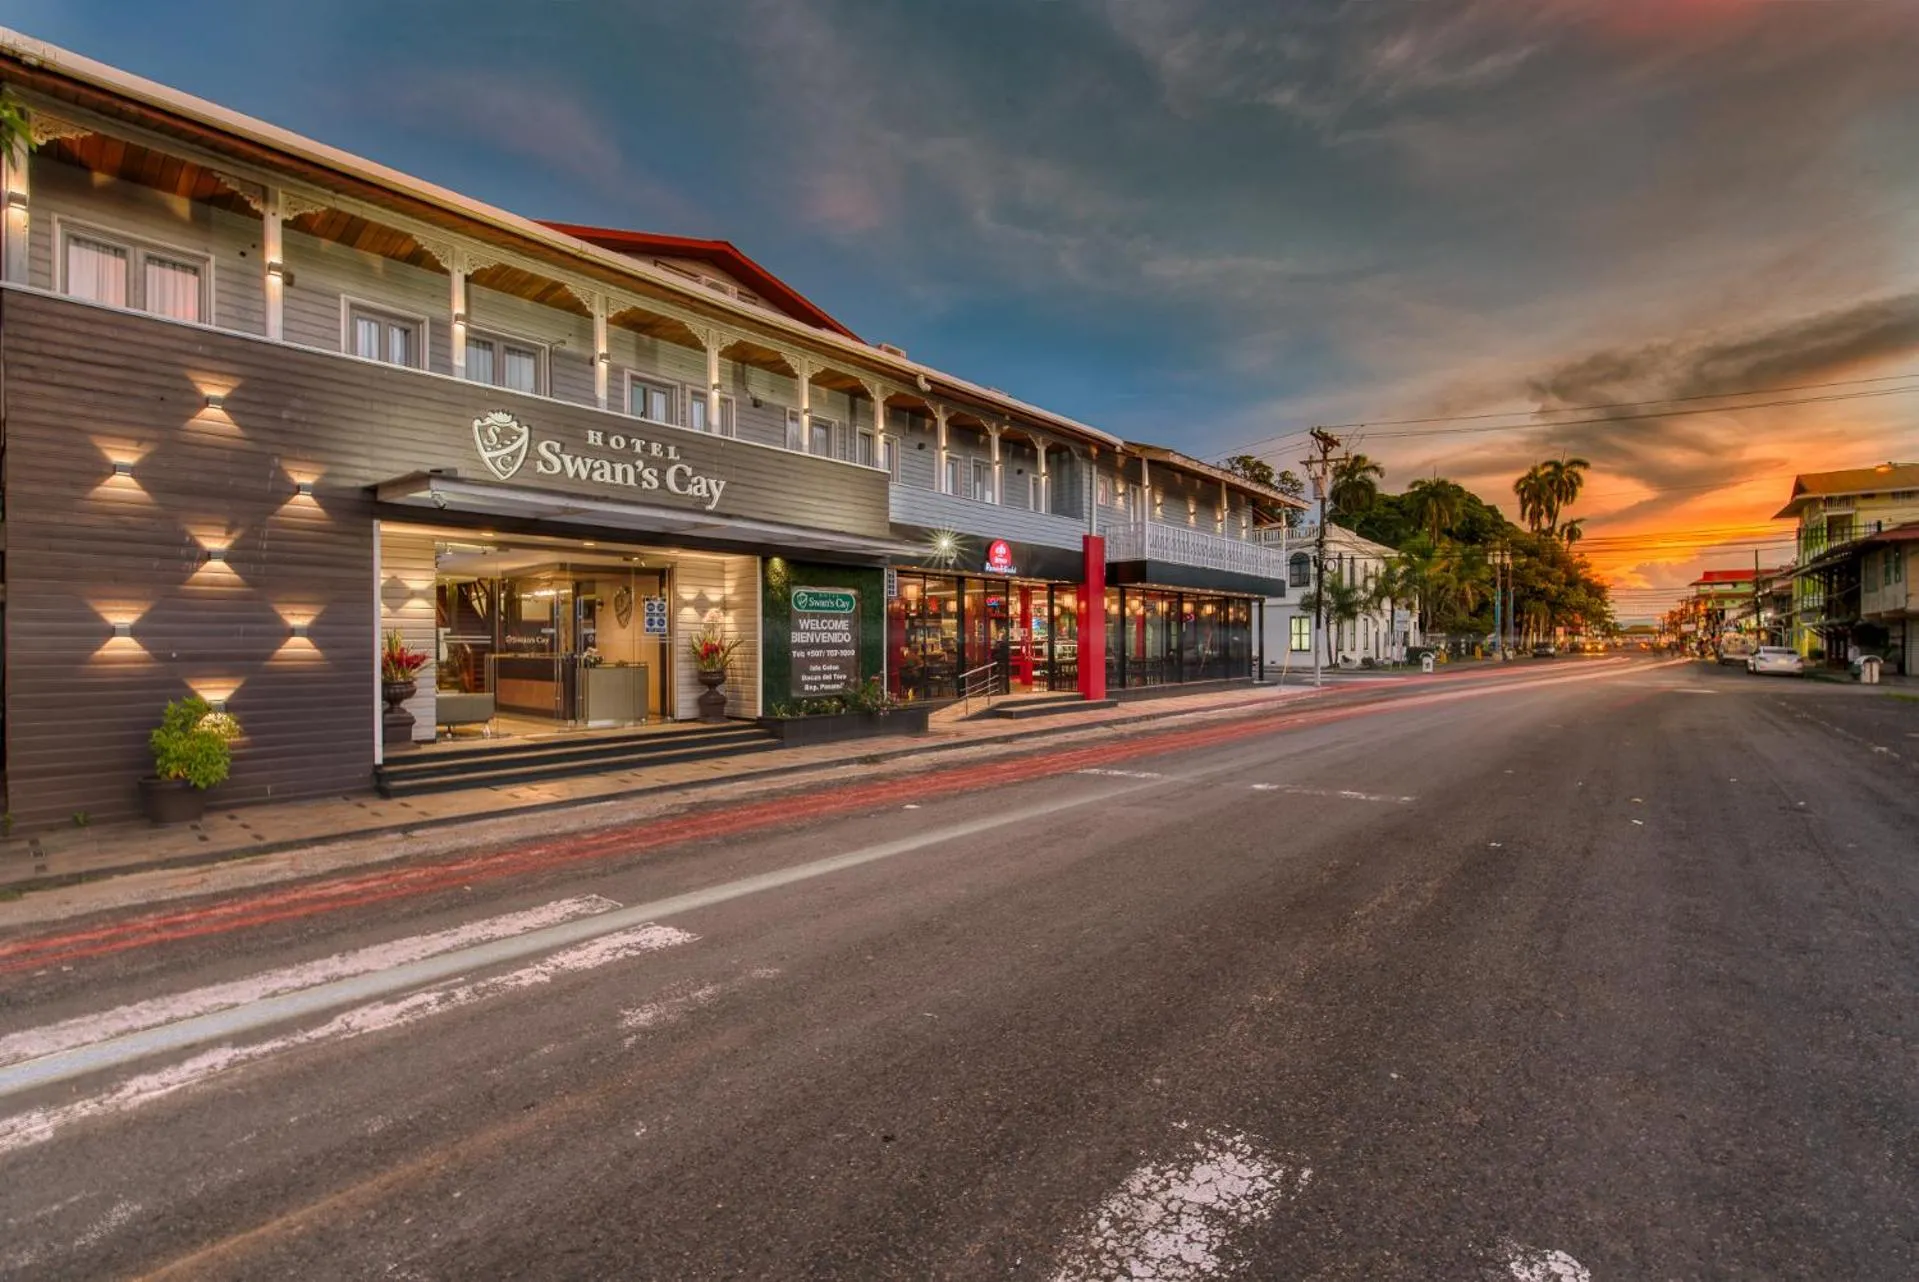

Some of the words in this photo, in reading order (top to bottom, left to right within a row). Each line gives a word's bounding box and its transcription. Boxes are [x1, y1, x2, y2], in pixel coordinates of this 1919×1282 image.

[483, 425, 500, 446] S
[587, 430, 680, 460] HOTEL
[536, 440, 659, 490] Swan's
[666, 464, 726, 510] Cay
[798, 619, 849, 630] WELCOME
[791, 631, 851, 643] BIENVENIDO
